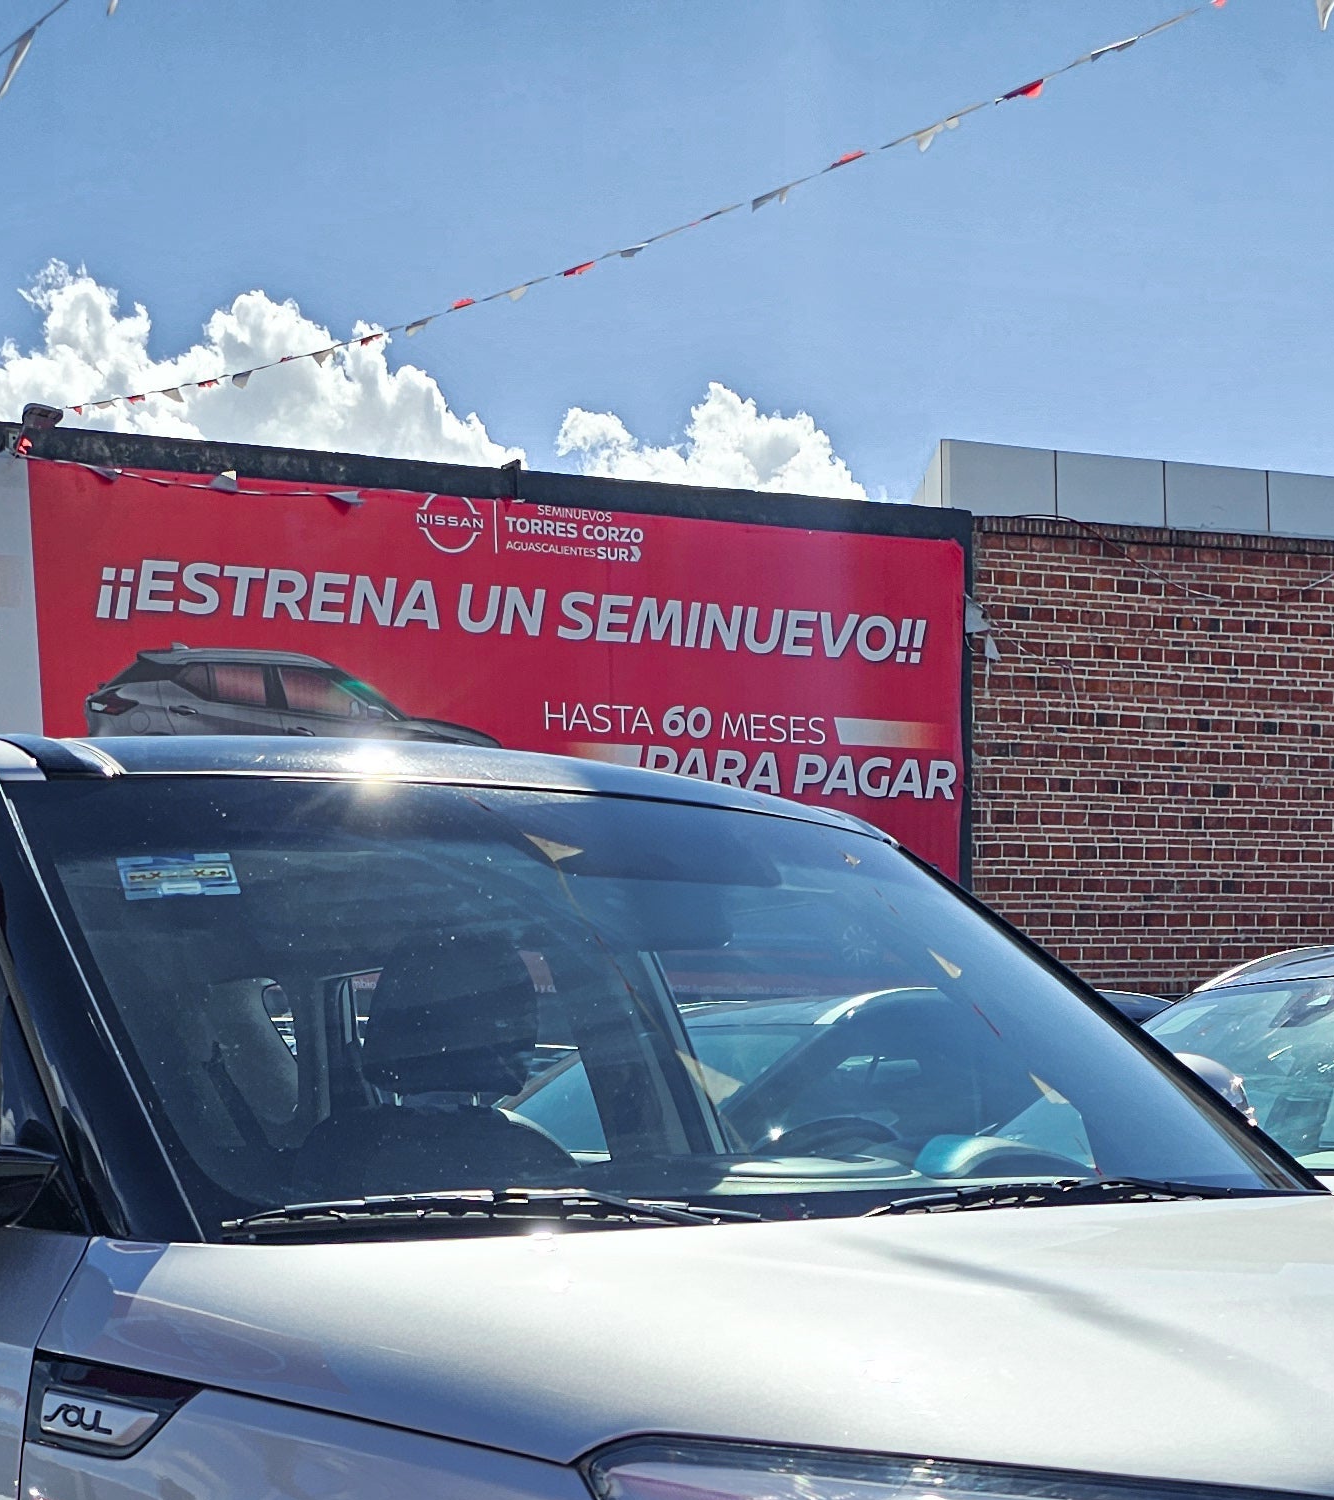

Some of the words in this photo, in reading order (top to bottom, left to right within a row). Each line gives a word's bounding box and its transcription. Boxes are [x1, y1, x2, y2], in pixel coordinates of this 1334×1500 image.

[416, 513, 485, 529] NISSAN
[537, 504, 613, 522] SEMINUEVOS
[505, 516, 578, 539] TORRES
[582, 525, 644, 543] CORZO
[505, 540, 596, 557] AGUASCALIENTES
[597, 546, 629, 562] SUR
[95, 559, 440, 630] ¡¡ESTRENA
[457, 583, 547, 636] UN
[557, 591, 927, 664] SEMINUEVO!!
[544, 701, 654, 735] HASTA
[662, 705, 712, 739] 60
[721, 711, 826, 744] MESES
[645, 745, 782, 794] PARA
[793, 754, 958, 800] PAGAR
